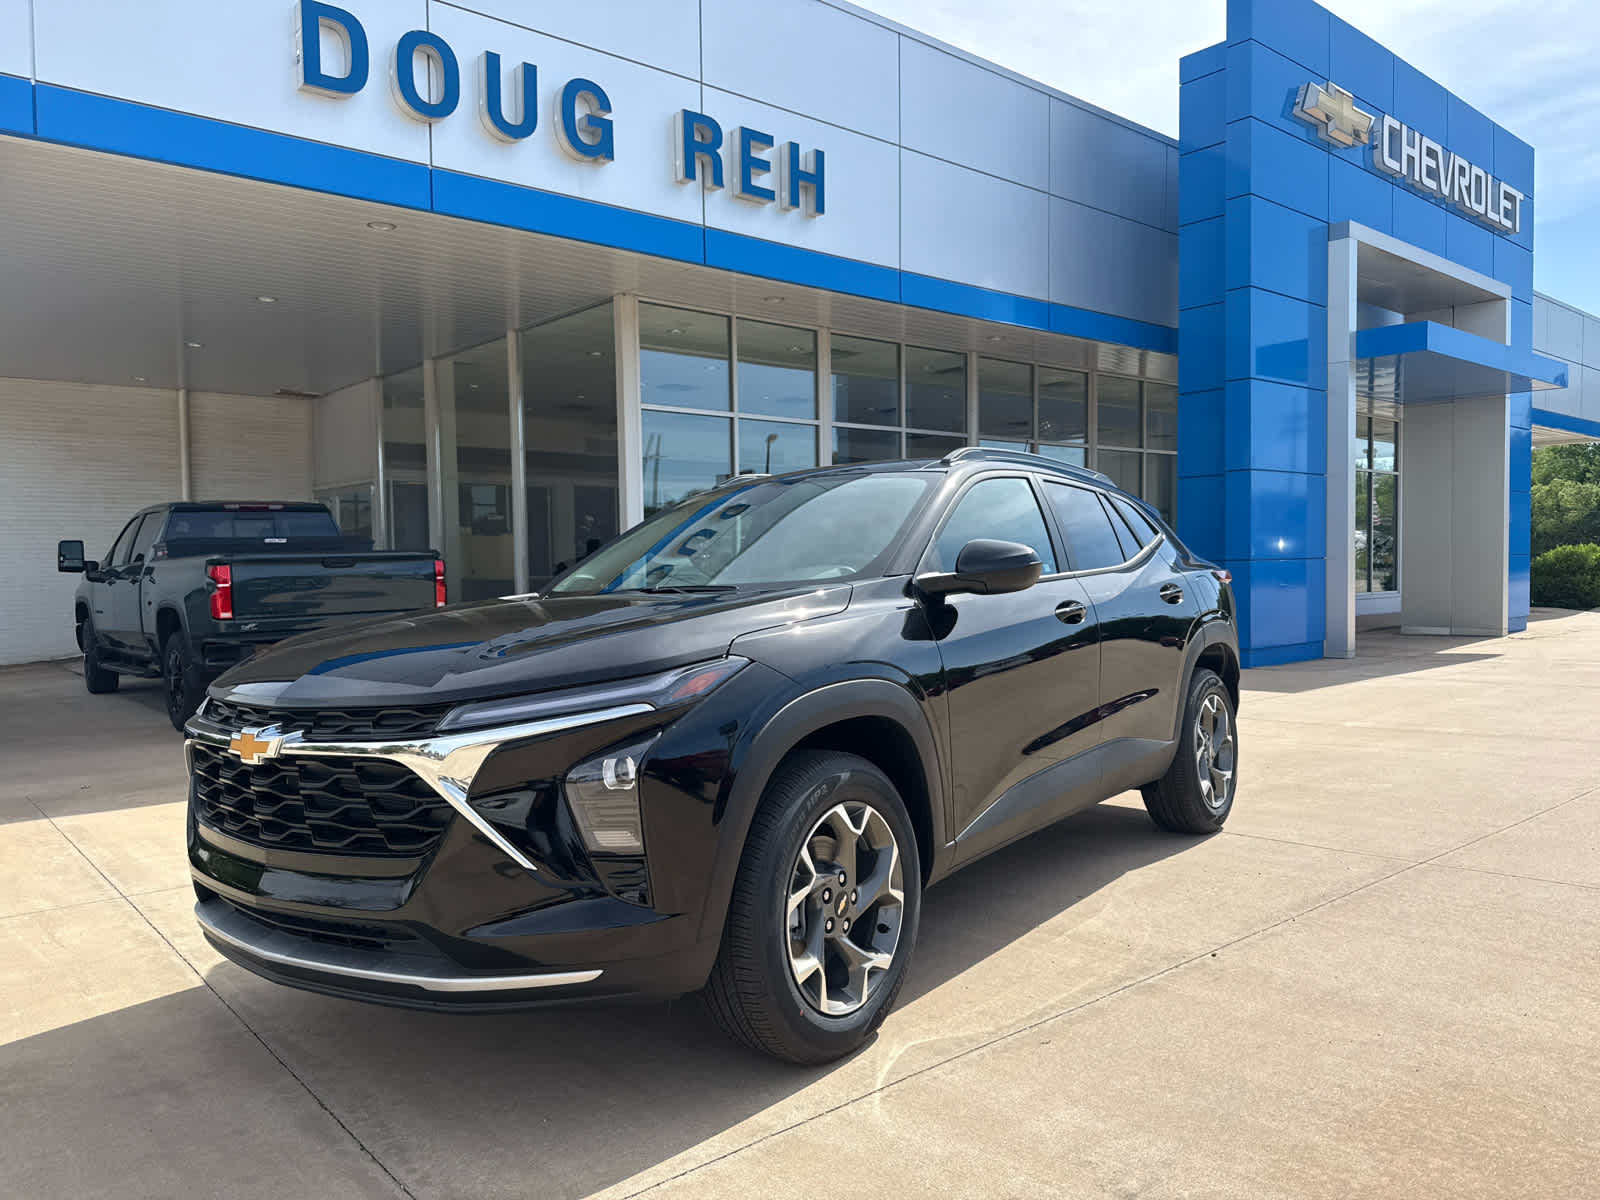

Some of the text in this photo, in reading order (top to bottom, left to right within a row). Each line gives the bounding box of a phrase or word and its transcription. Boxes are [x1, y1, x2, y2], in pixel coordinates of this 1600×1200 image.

[300, 0, 825, 216] DOUG REH
[1382, 113, 1525, 234] CHEVROLET
